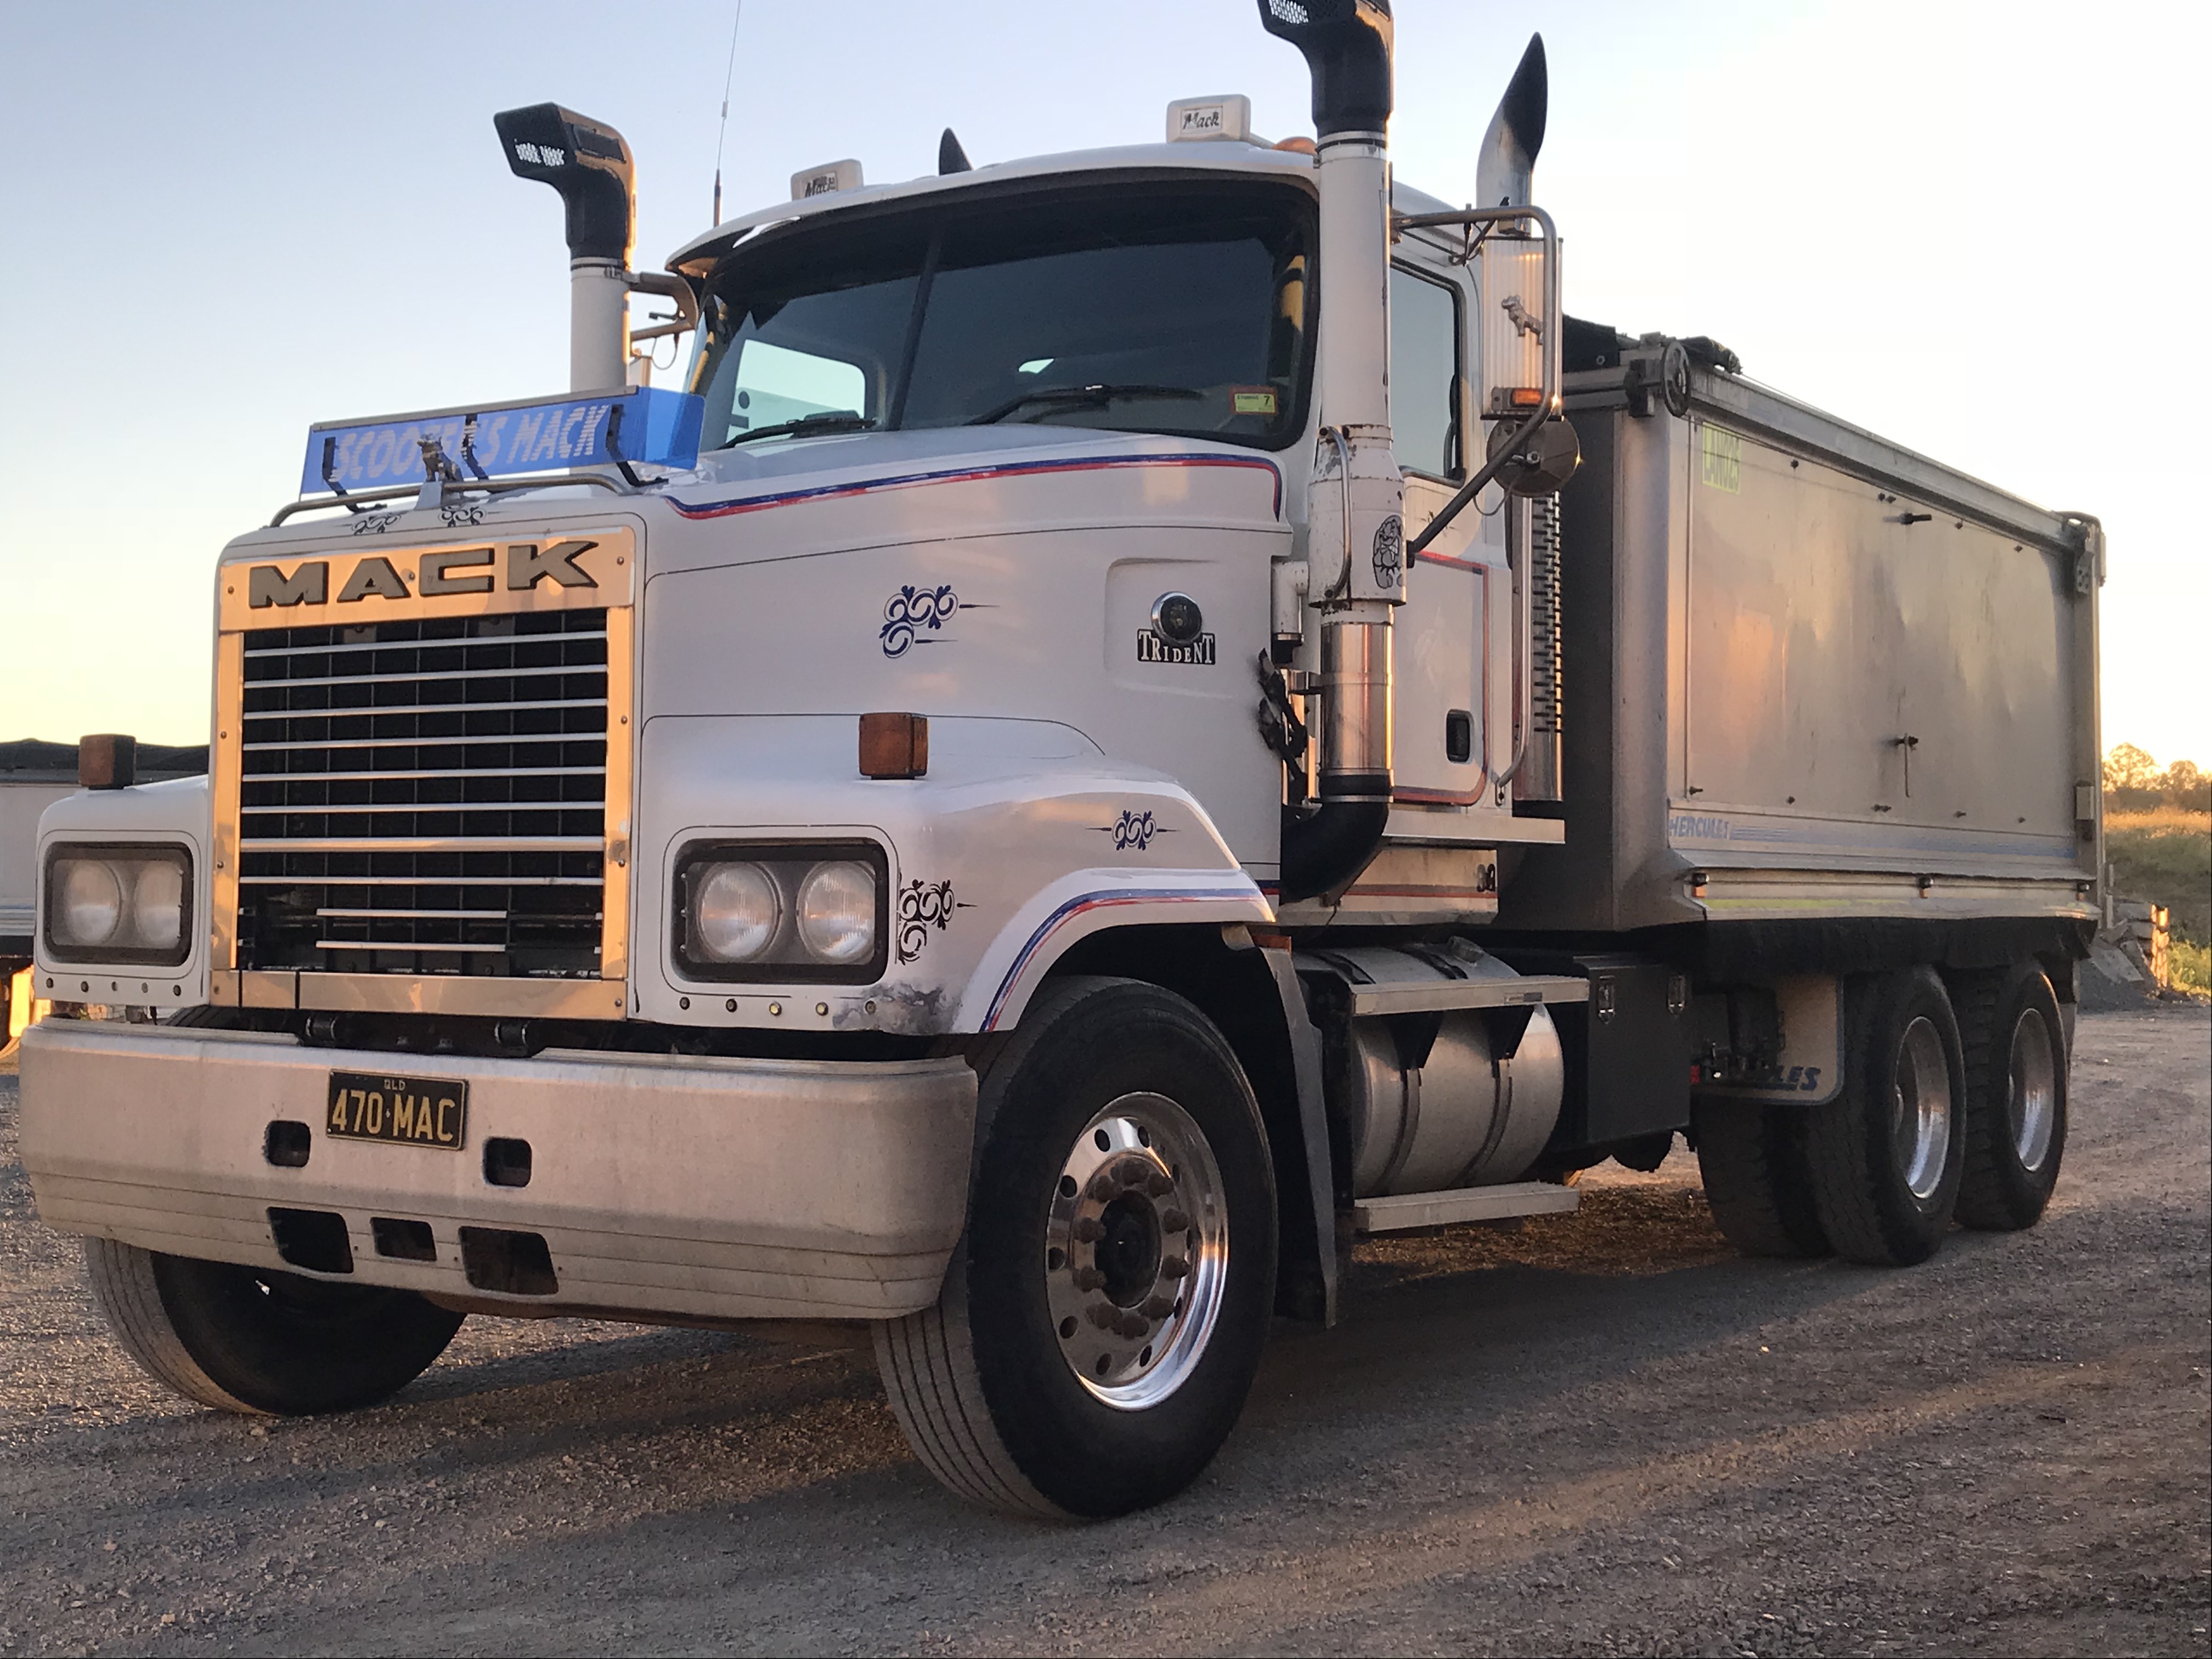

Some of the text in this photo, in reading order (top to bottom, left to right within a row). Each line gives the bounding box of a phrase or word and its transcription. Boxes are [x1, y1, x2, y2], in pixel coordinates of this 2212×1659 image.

[1182, 111, 1220, 129] Mack
[1263, 395, 1271, 407] 7
[506, 404, 610, 464] MACK
[249, 540, 599, 608] MACK
[1138, 630, 1214, 664] TRIDENT
[384, 1079, 406, 1091] QLD
